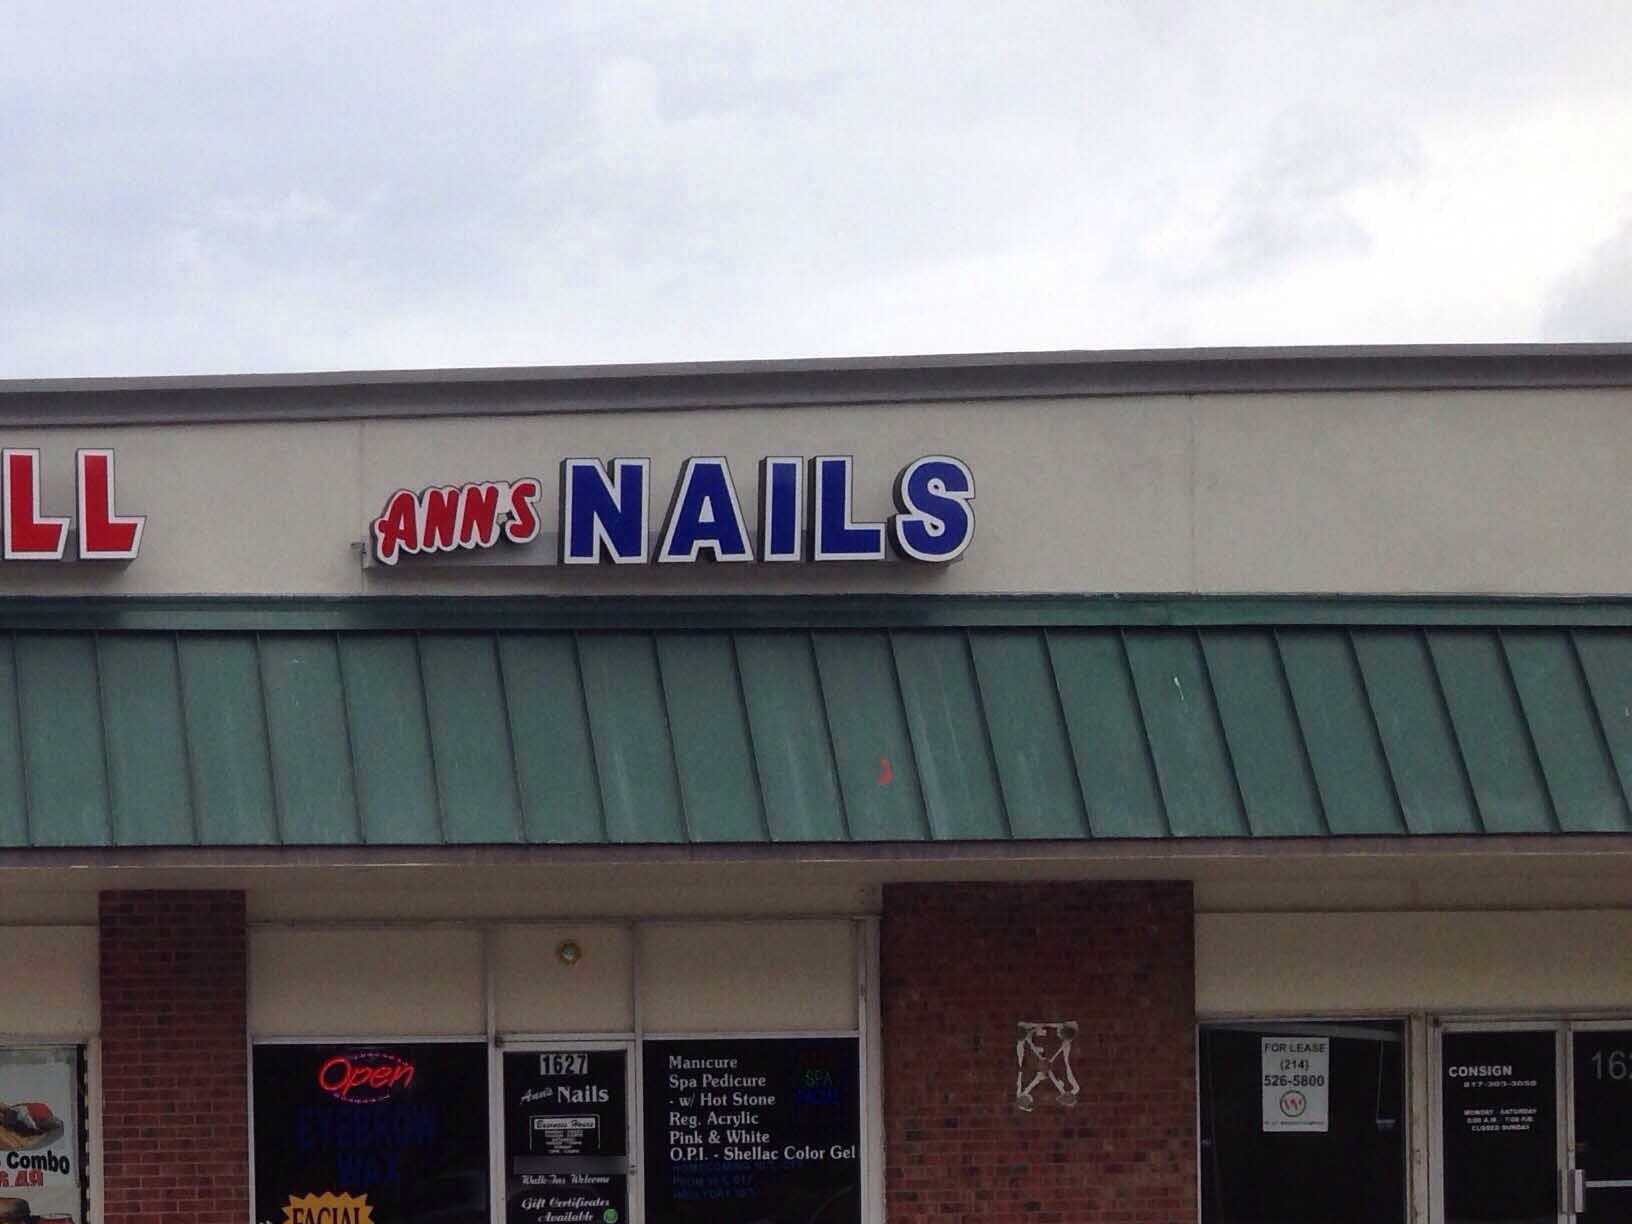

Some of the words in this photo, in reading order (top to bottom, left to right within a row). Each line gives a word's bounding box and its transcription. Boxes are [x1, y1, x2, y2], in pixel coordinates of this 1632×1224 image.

[373, 478, 541, 565] ANN'S
[561, 455, 975, 564] NAILS
[1264, 1043, 1287, 1053] FOR
[1289, 1042, 1328, 1053] LEASE
[541, 1055, 587, 1075] 1627
[669, 1055, 738, 1069] Manicure
[1280, 1059, 1310, 1071] (214)
[1591, 1049, 1632, 1081] 16
[319, 1056, 415, 1096] Open
[1448, 1065, 1513, 1077] CONSIGN
[669, 1074, 697, 1091] Spa
[702, 1073, 766, 1088] Pedicure
[1264, 1074, 1326, 1088] 526-5800
[557, 1085, 609, 1103] Nails
[700, 1092, 727, 1106] Hot
[732, 1091, 776, 1106] Stone
[669, 1111, 701, 1128] Reg.
[707, 1111, 760, 1128] Acrylic
[670, 1130, 703, 1144] Pink
[708, 1130, 720, 1144] &
[726, 1129, 770, 1144] White
[670, 1146, 707, 1161] O.P.I.
[723, 1146, 779, 1161] Shellac
[784, 1146, 826, 1160] Color
[829, 1145, 857, 1160] Gel
[6, 1150, 71, 1175] Combo
[570, 1173, 611, 1184] Welcome
[521, 1197, 546, 1210] Gift
[549, 1197, 610, 1209] Certificates
[537, 1211, 594, 1223] Available
